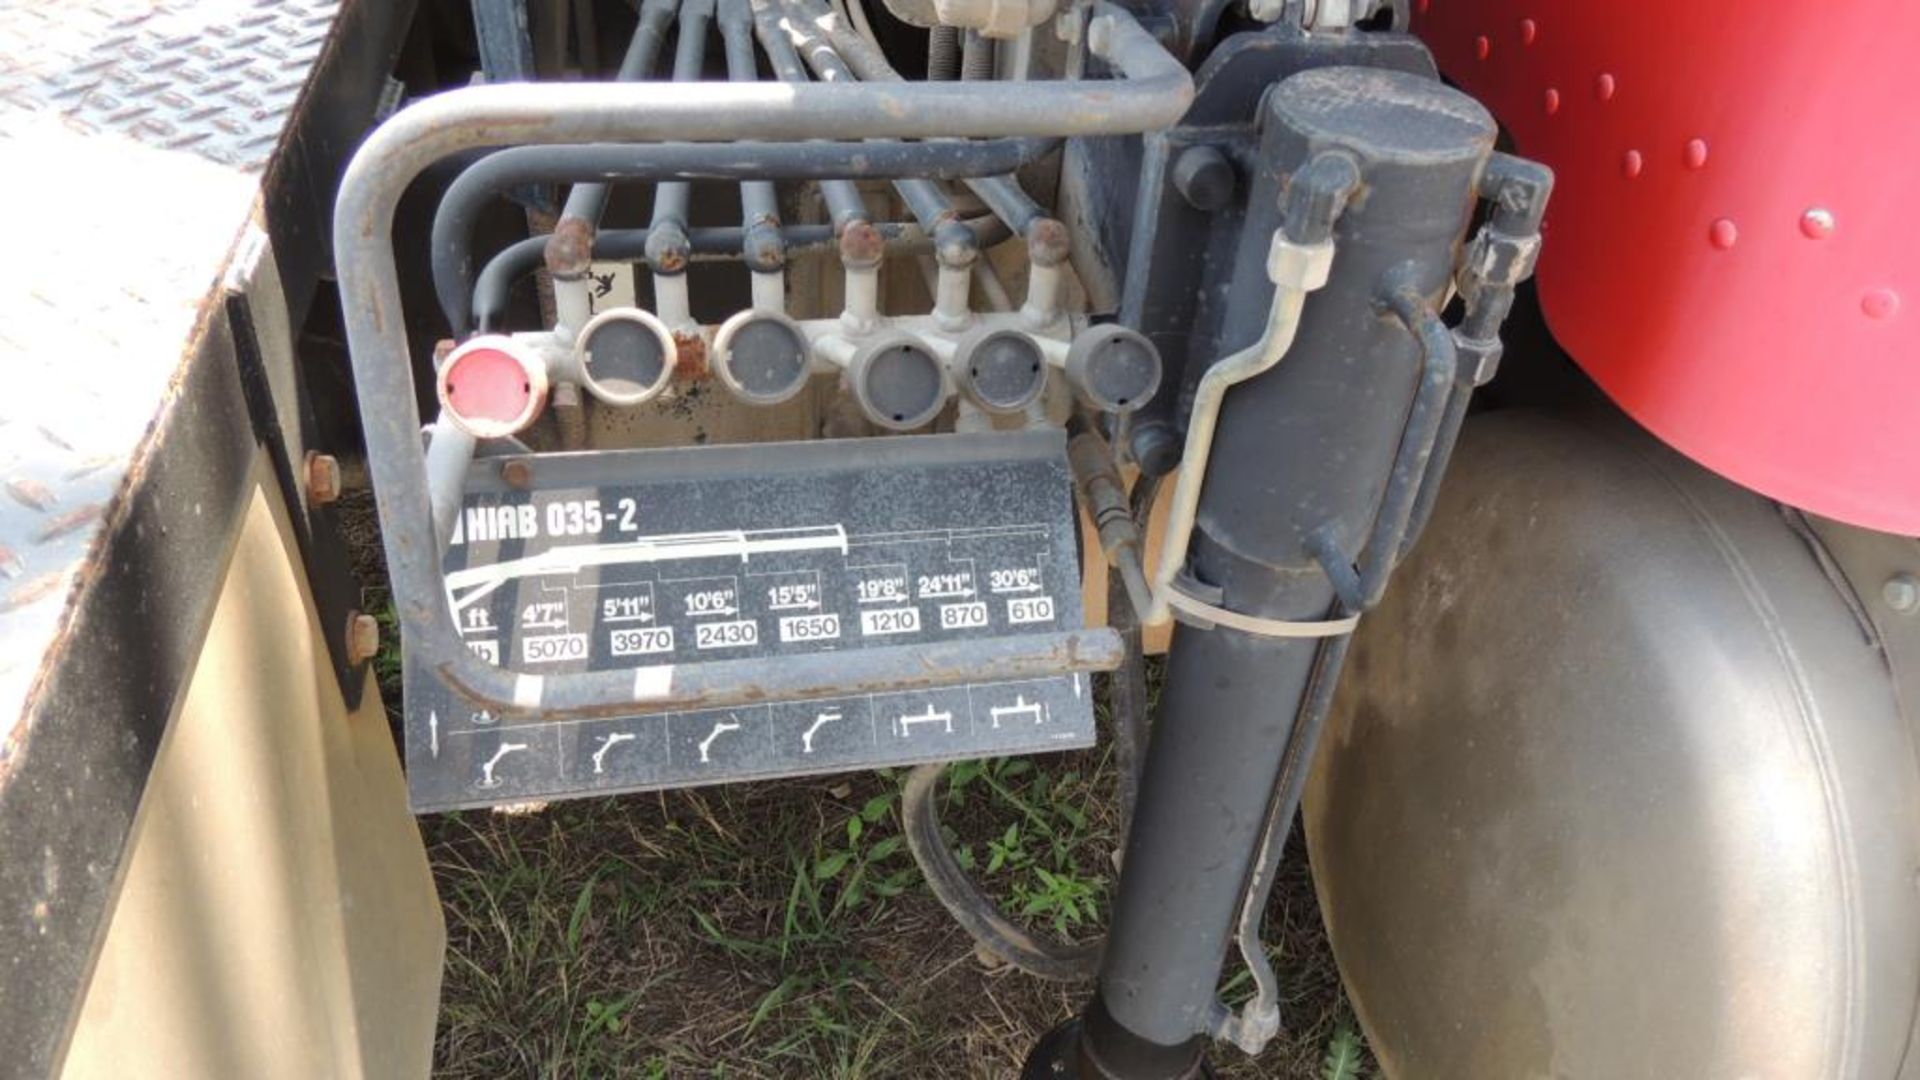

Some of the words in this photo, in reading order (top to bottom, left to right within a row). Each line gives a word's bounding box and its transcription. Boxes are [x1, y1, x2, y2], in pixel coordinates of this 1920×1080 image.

[467, 504, 537, 541] HIAB
[547, 498, 638, 536] 035-2
[467, 607, 489, 626] ft
[522, 602, 564, 622] 4'7"
[603, 596, 649, 616] 5'11"
[684, 589, 734, 611] 10'6"
[768, 584, 816, 605] 15'5"
[857, 577, 903, 598] 19'8"
[918, 573, 970, 592] 24'11"
[990, 568, 1037, 588] 30'6"
[527, 636, 584, 659] 5070
[614, 630, 671, 652] 3970
[700, 623, 755, 645] 2430
[786, 617, 838, 638] 1650
[869, 611, 915, 632] 1210
[944, 605, 985, 626] 870
[1012, 600, 1050, 620] 610
